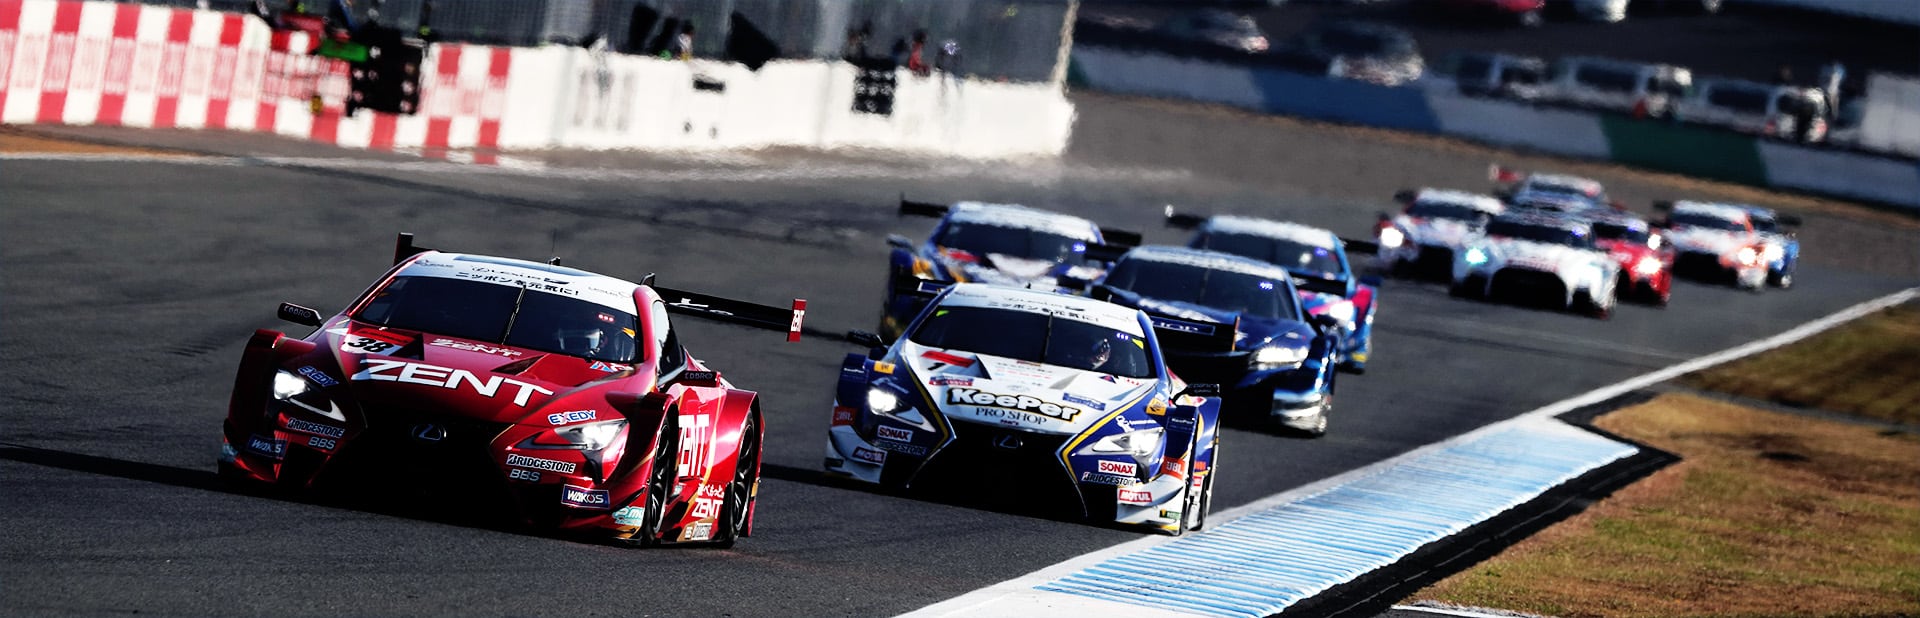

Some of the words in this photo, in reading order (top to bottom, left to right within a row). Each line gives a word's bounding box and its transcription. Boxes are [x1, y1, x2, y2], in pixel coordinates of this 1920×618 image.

[347, 338, 394, 352] 38
[430, 339, 522, 357] ZENT
[298, 366, 339, 387] EXEDY
[351, 359, 554, 407] ZENT
[947, 388, 1081, 422] KeePer
[549, 411, 596, 424] EXEDY
[976, 406, 1006, 418] PRO
[1008, 411, 1047, 425] SHOP
[287, 417, 345, 438] BRIDGESTONE
[880, 427, 909, 440] SONAX
[308, 436, 336, 450] BBS
[679, 414, 709, 476] ZENT
[507, 454, 576, 474] BRIDGESTONE
[1100, 462, 1134, 474] SONAX
[1166, 462, 1183, 473] JBL
[510, 469, 540, 481] BBS
[1082, 472, 1136, 487] BRIDGESTONE
[1120, 492, 1151, 501] MOTUL
[692, 497, 723, 519] ZENT
